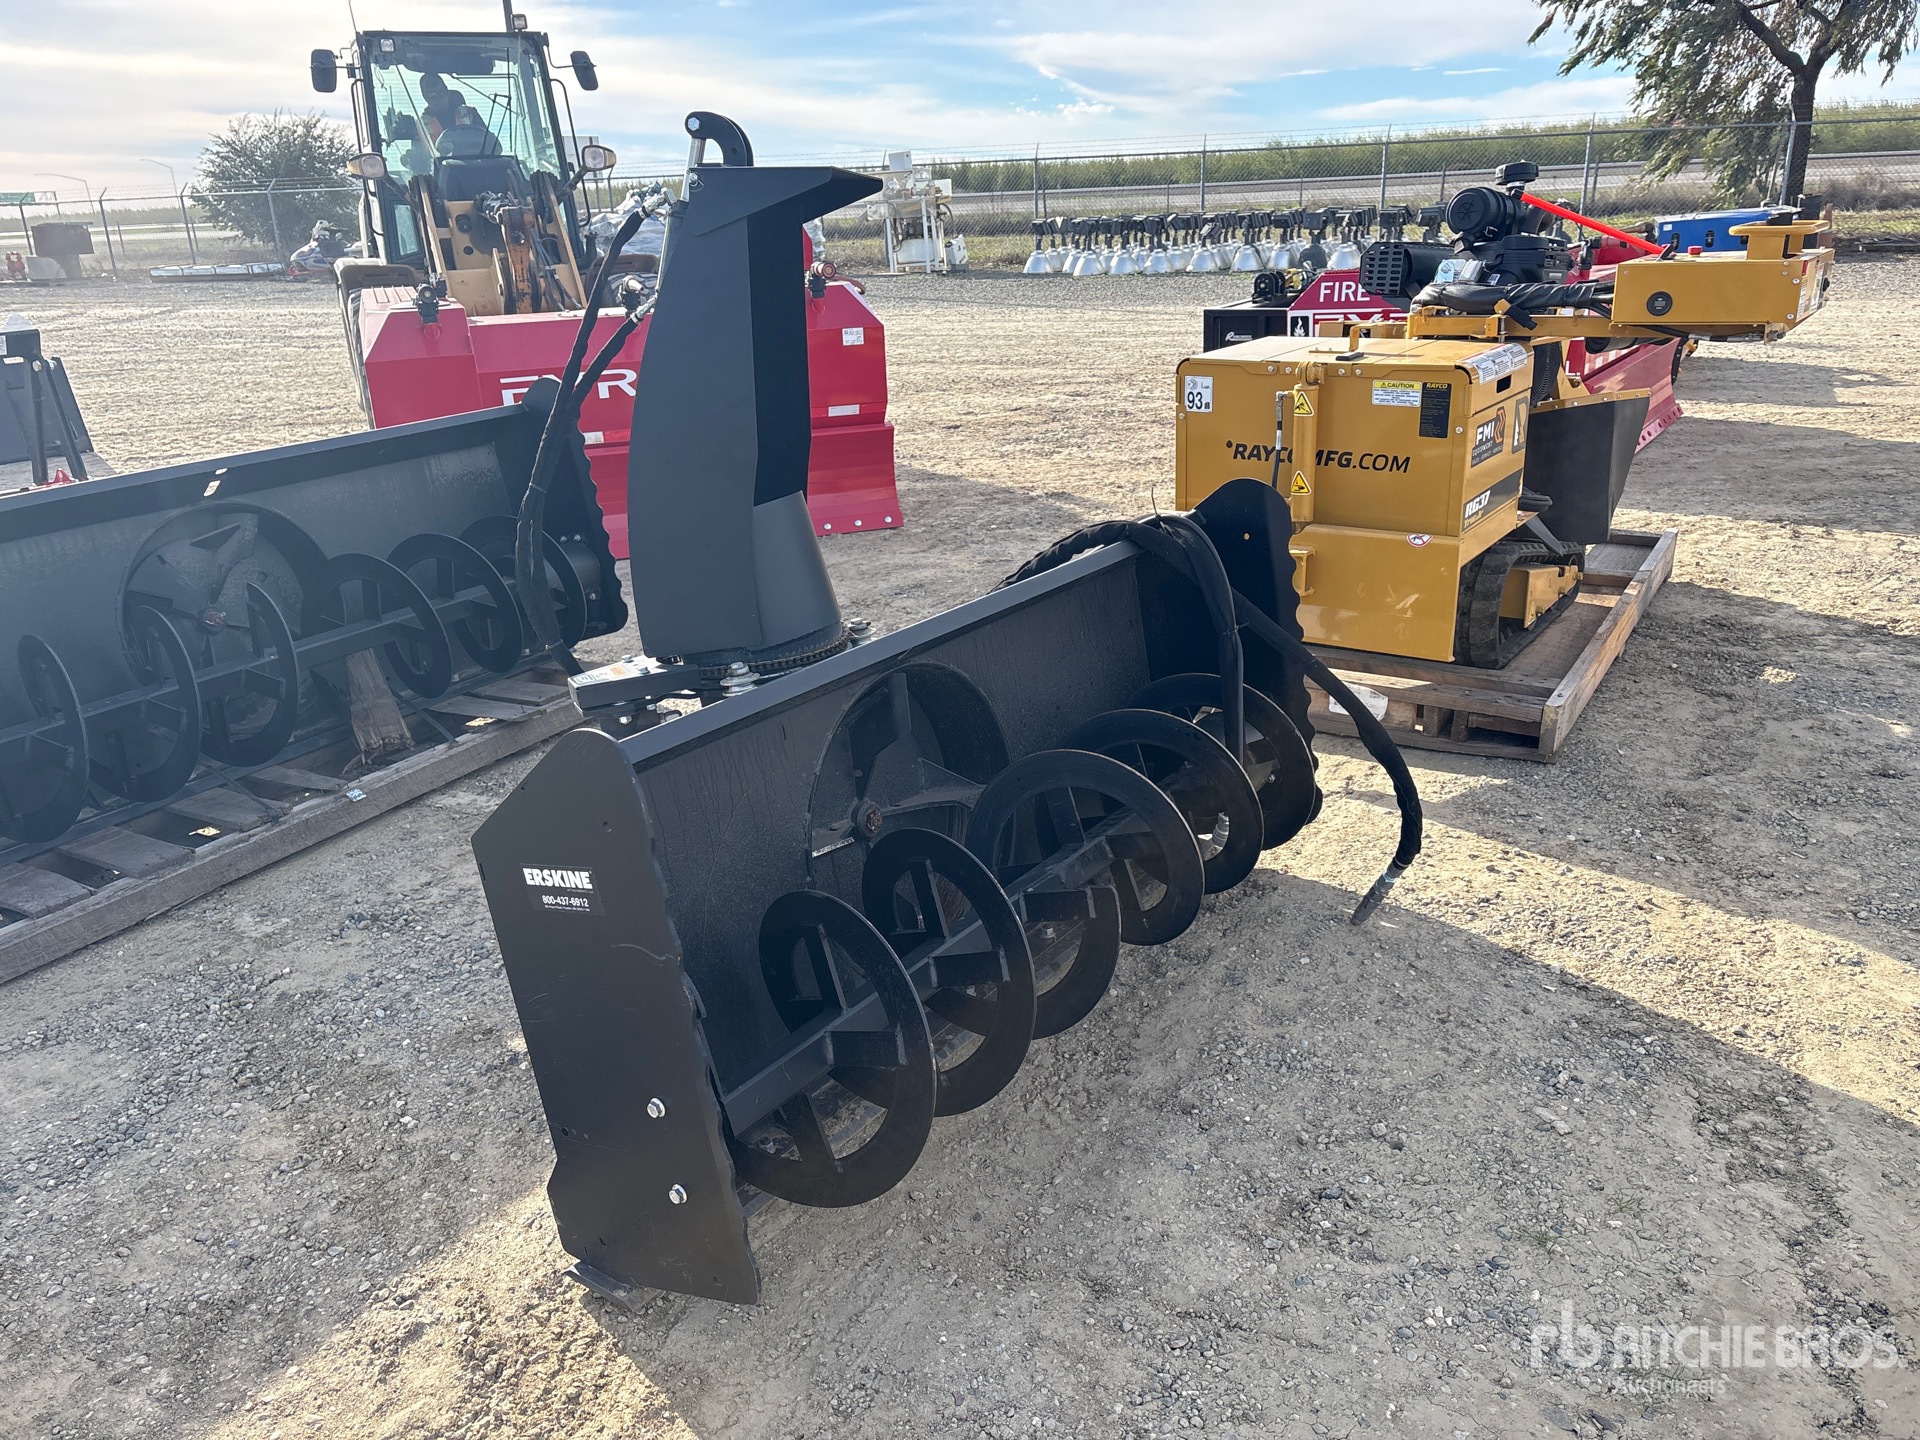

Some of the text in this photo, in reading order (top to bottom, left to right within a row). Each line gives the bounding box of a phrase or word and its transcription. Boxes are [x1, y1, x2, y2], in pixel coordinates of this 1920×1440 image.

[1319, 281, 1370, 303] FIRE
[1187, 391, 1203, 410] 93
[1476, 420, 1495, 446] FMI
[1232, 443, 1411, 474] RAYCFG.COM
[1464, 490, 1491, 519] RG37
[522, 867, 593, 889] ERSKINE
[541, 894, 589, 908] 800-437-6912
